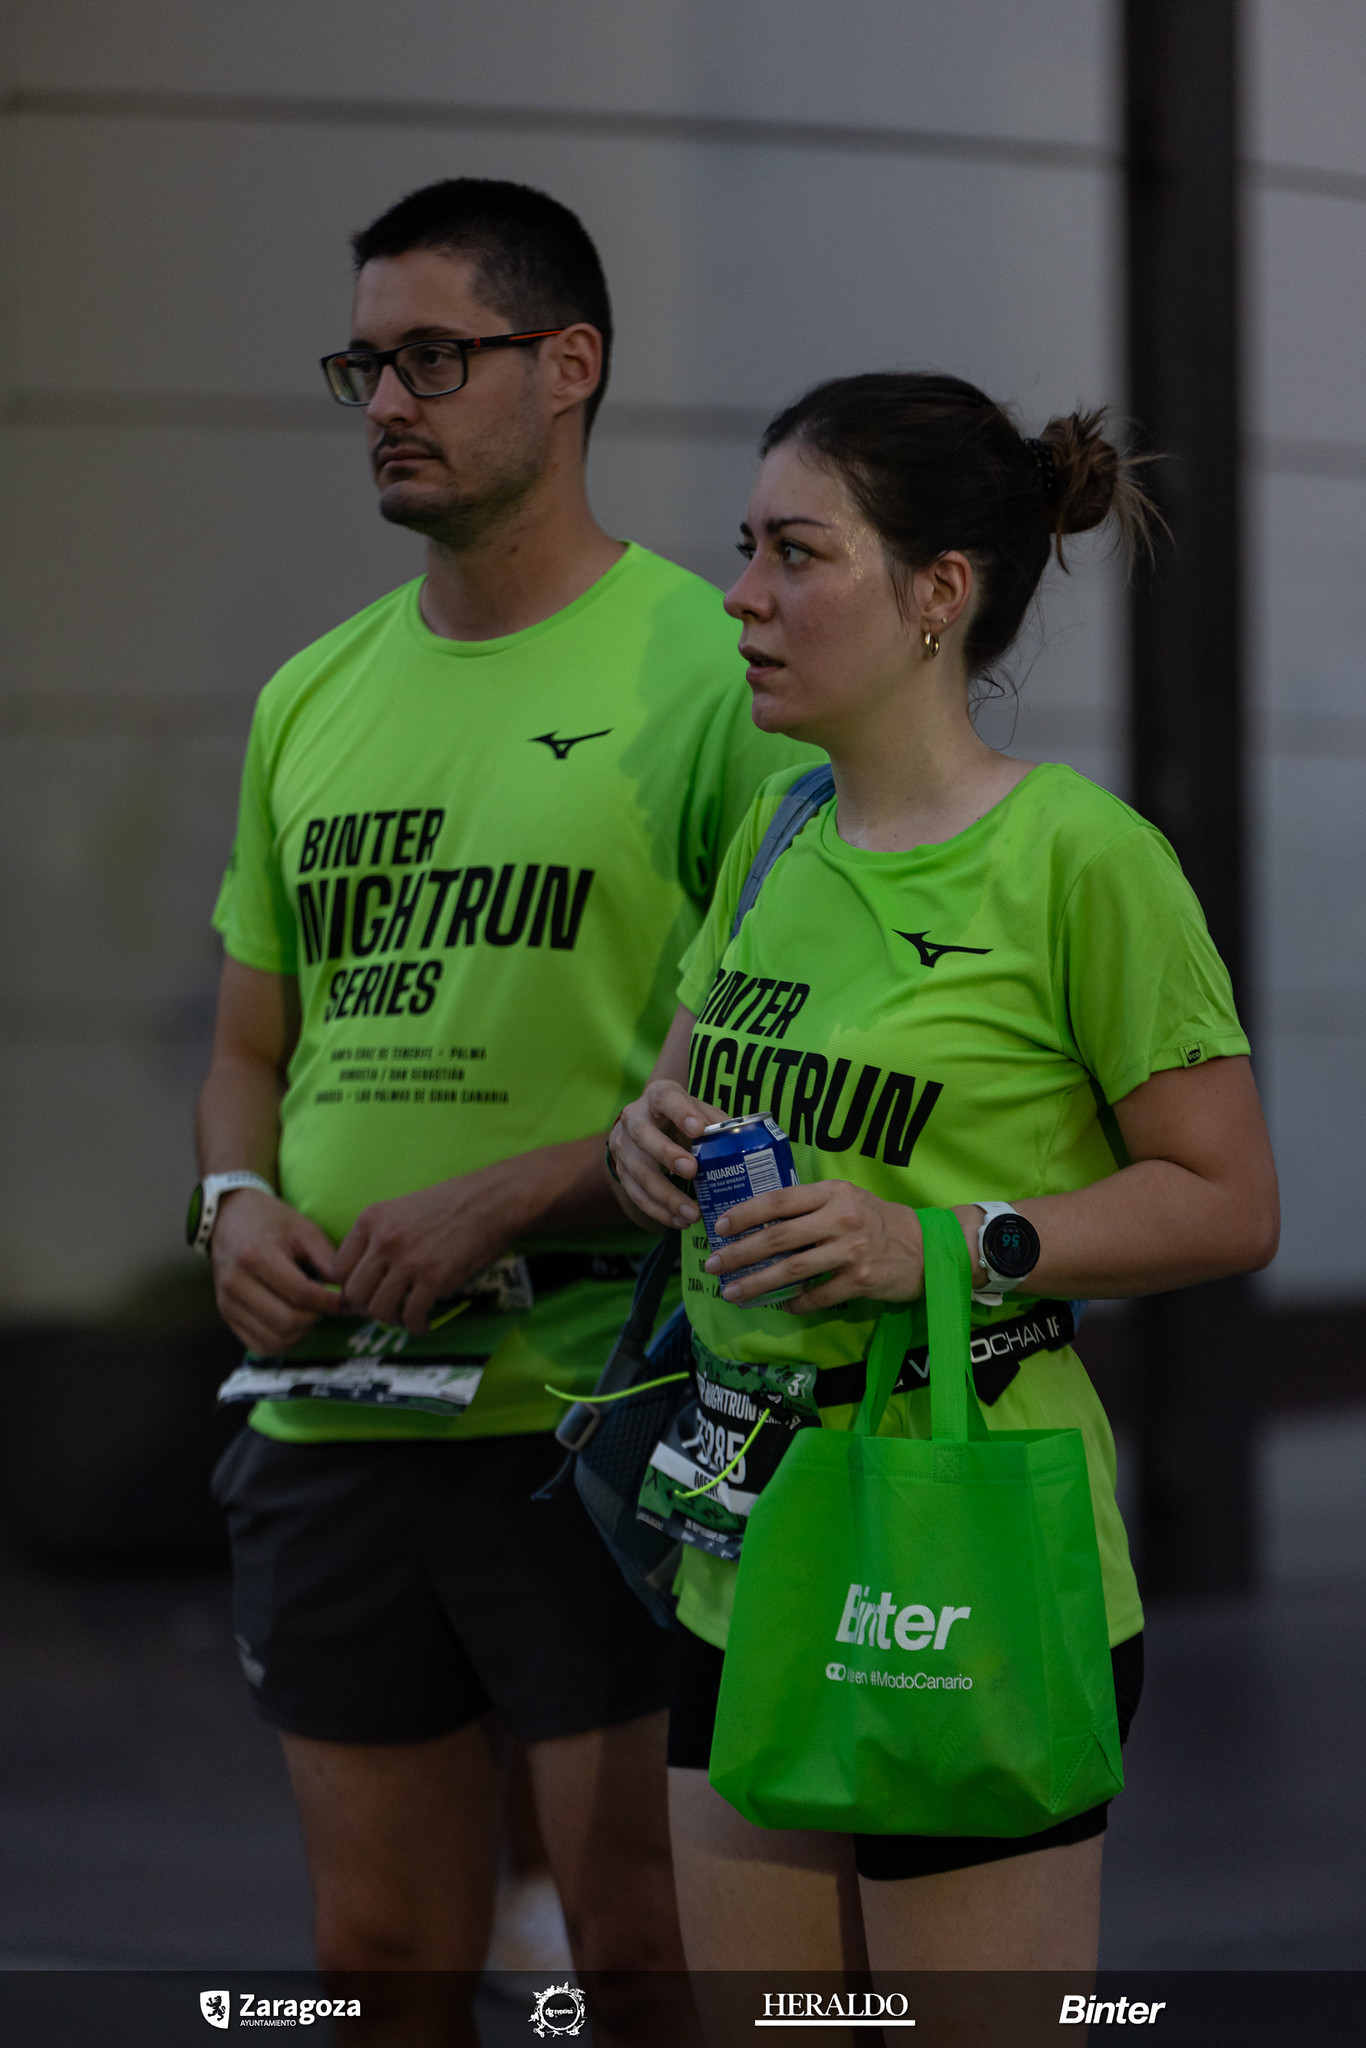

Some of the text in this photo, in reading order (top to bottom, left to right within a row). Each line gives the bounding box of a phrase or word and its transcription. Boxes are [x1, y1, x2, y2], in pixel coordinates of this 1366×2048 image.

[300, 809, 444, 873] BINTER
[298, 864, 595, 965] NIGHTRUN
[325, 961, 443, 1023] SERIES
[689, 1034, 944, 1167] IGHTRUN
[706, 1163, 745, 1182] AQUARIUS
[835, 1583, 972, 1651] Binter
[870, 1671, 973, 1690] #ModoCanario
